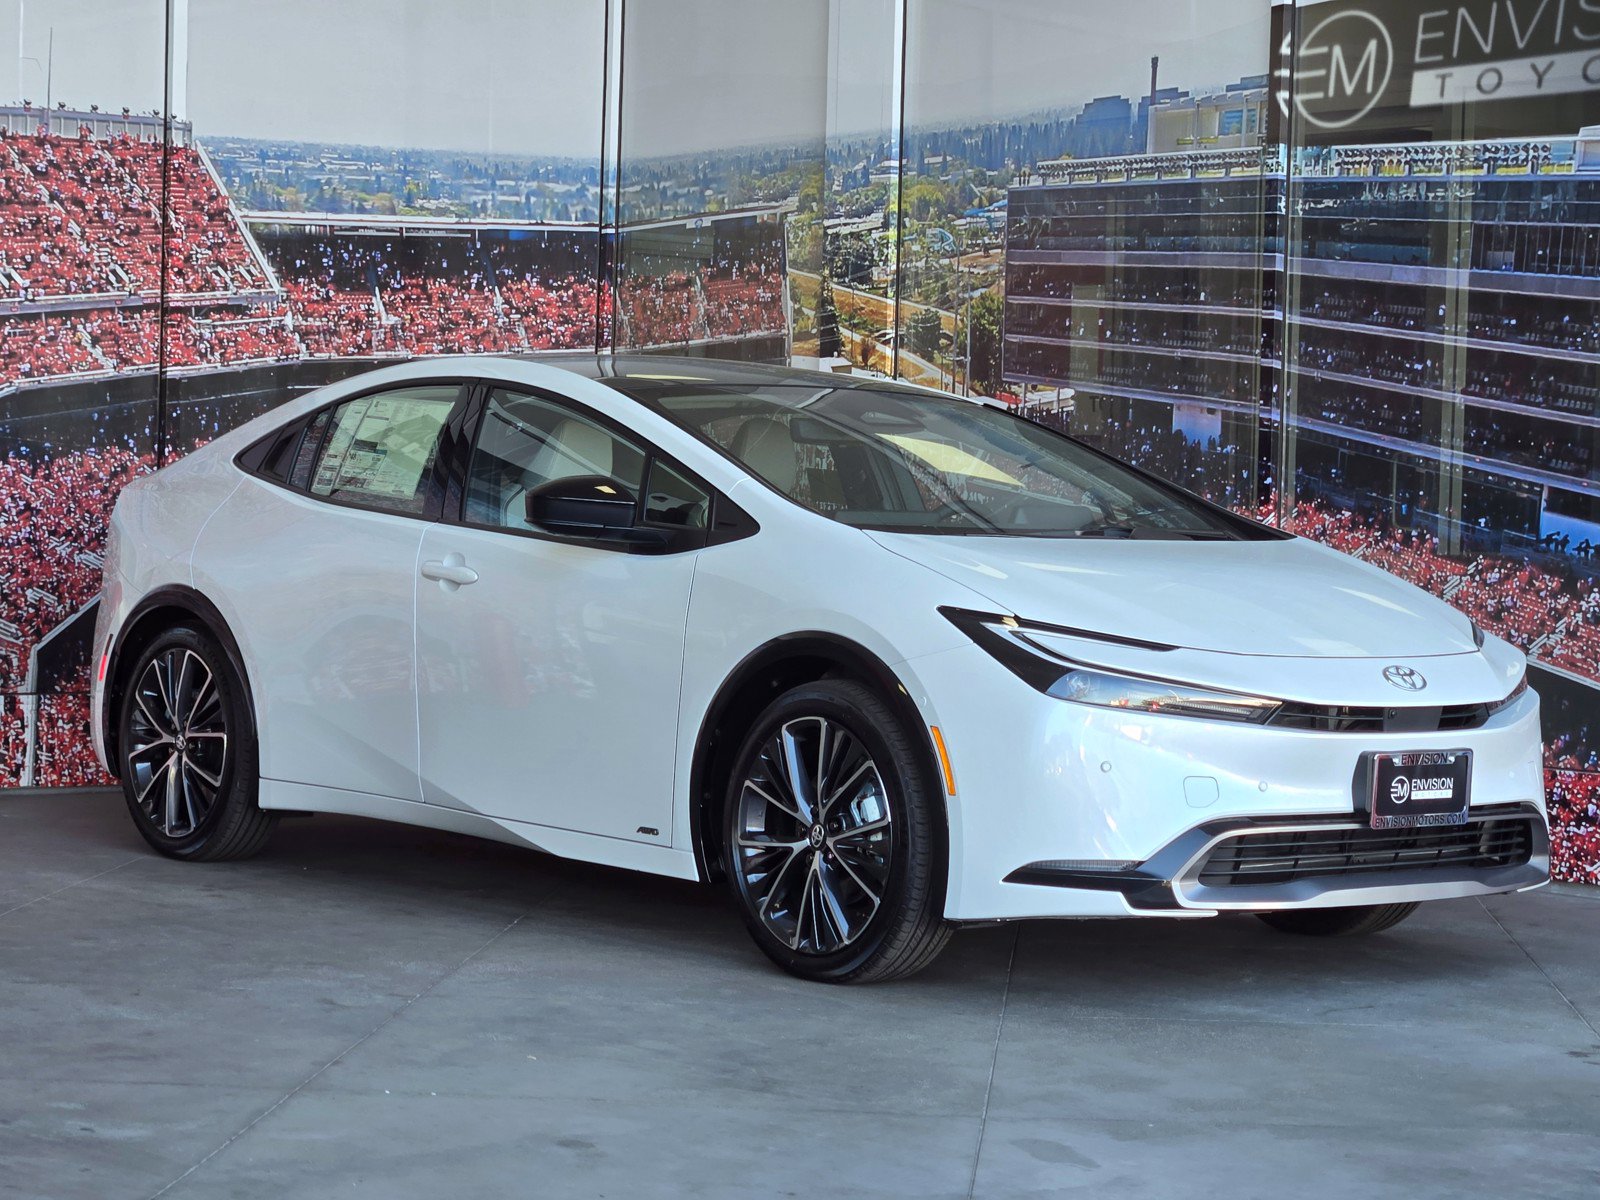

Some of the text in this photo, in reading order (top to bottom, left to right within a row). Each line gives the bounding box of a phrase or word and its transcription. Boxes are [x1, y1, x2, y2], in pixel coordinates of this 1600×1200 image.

[1401, 752, 1448, 765] ENVISION
[1411, 778, 1453, 790] ENVISION
[1375, 813, 1464, 828] ENVISIONMOTORS.COM
